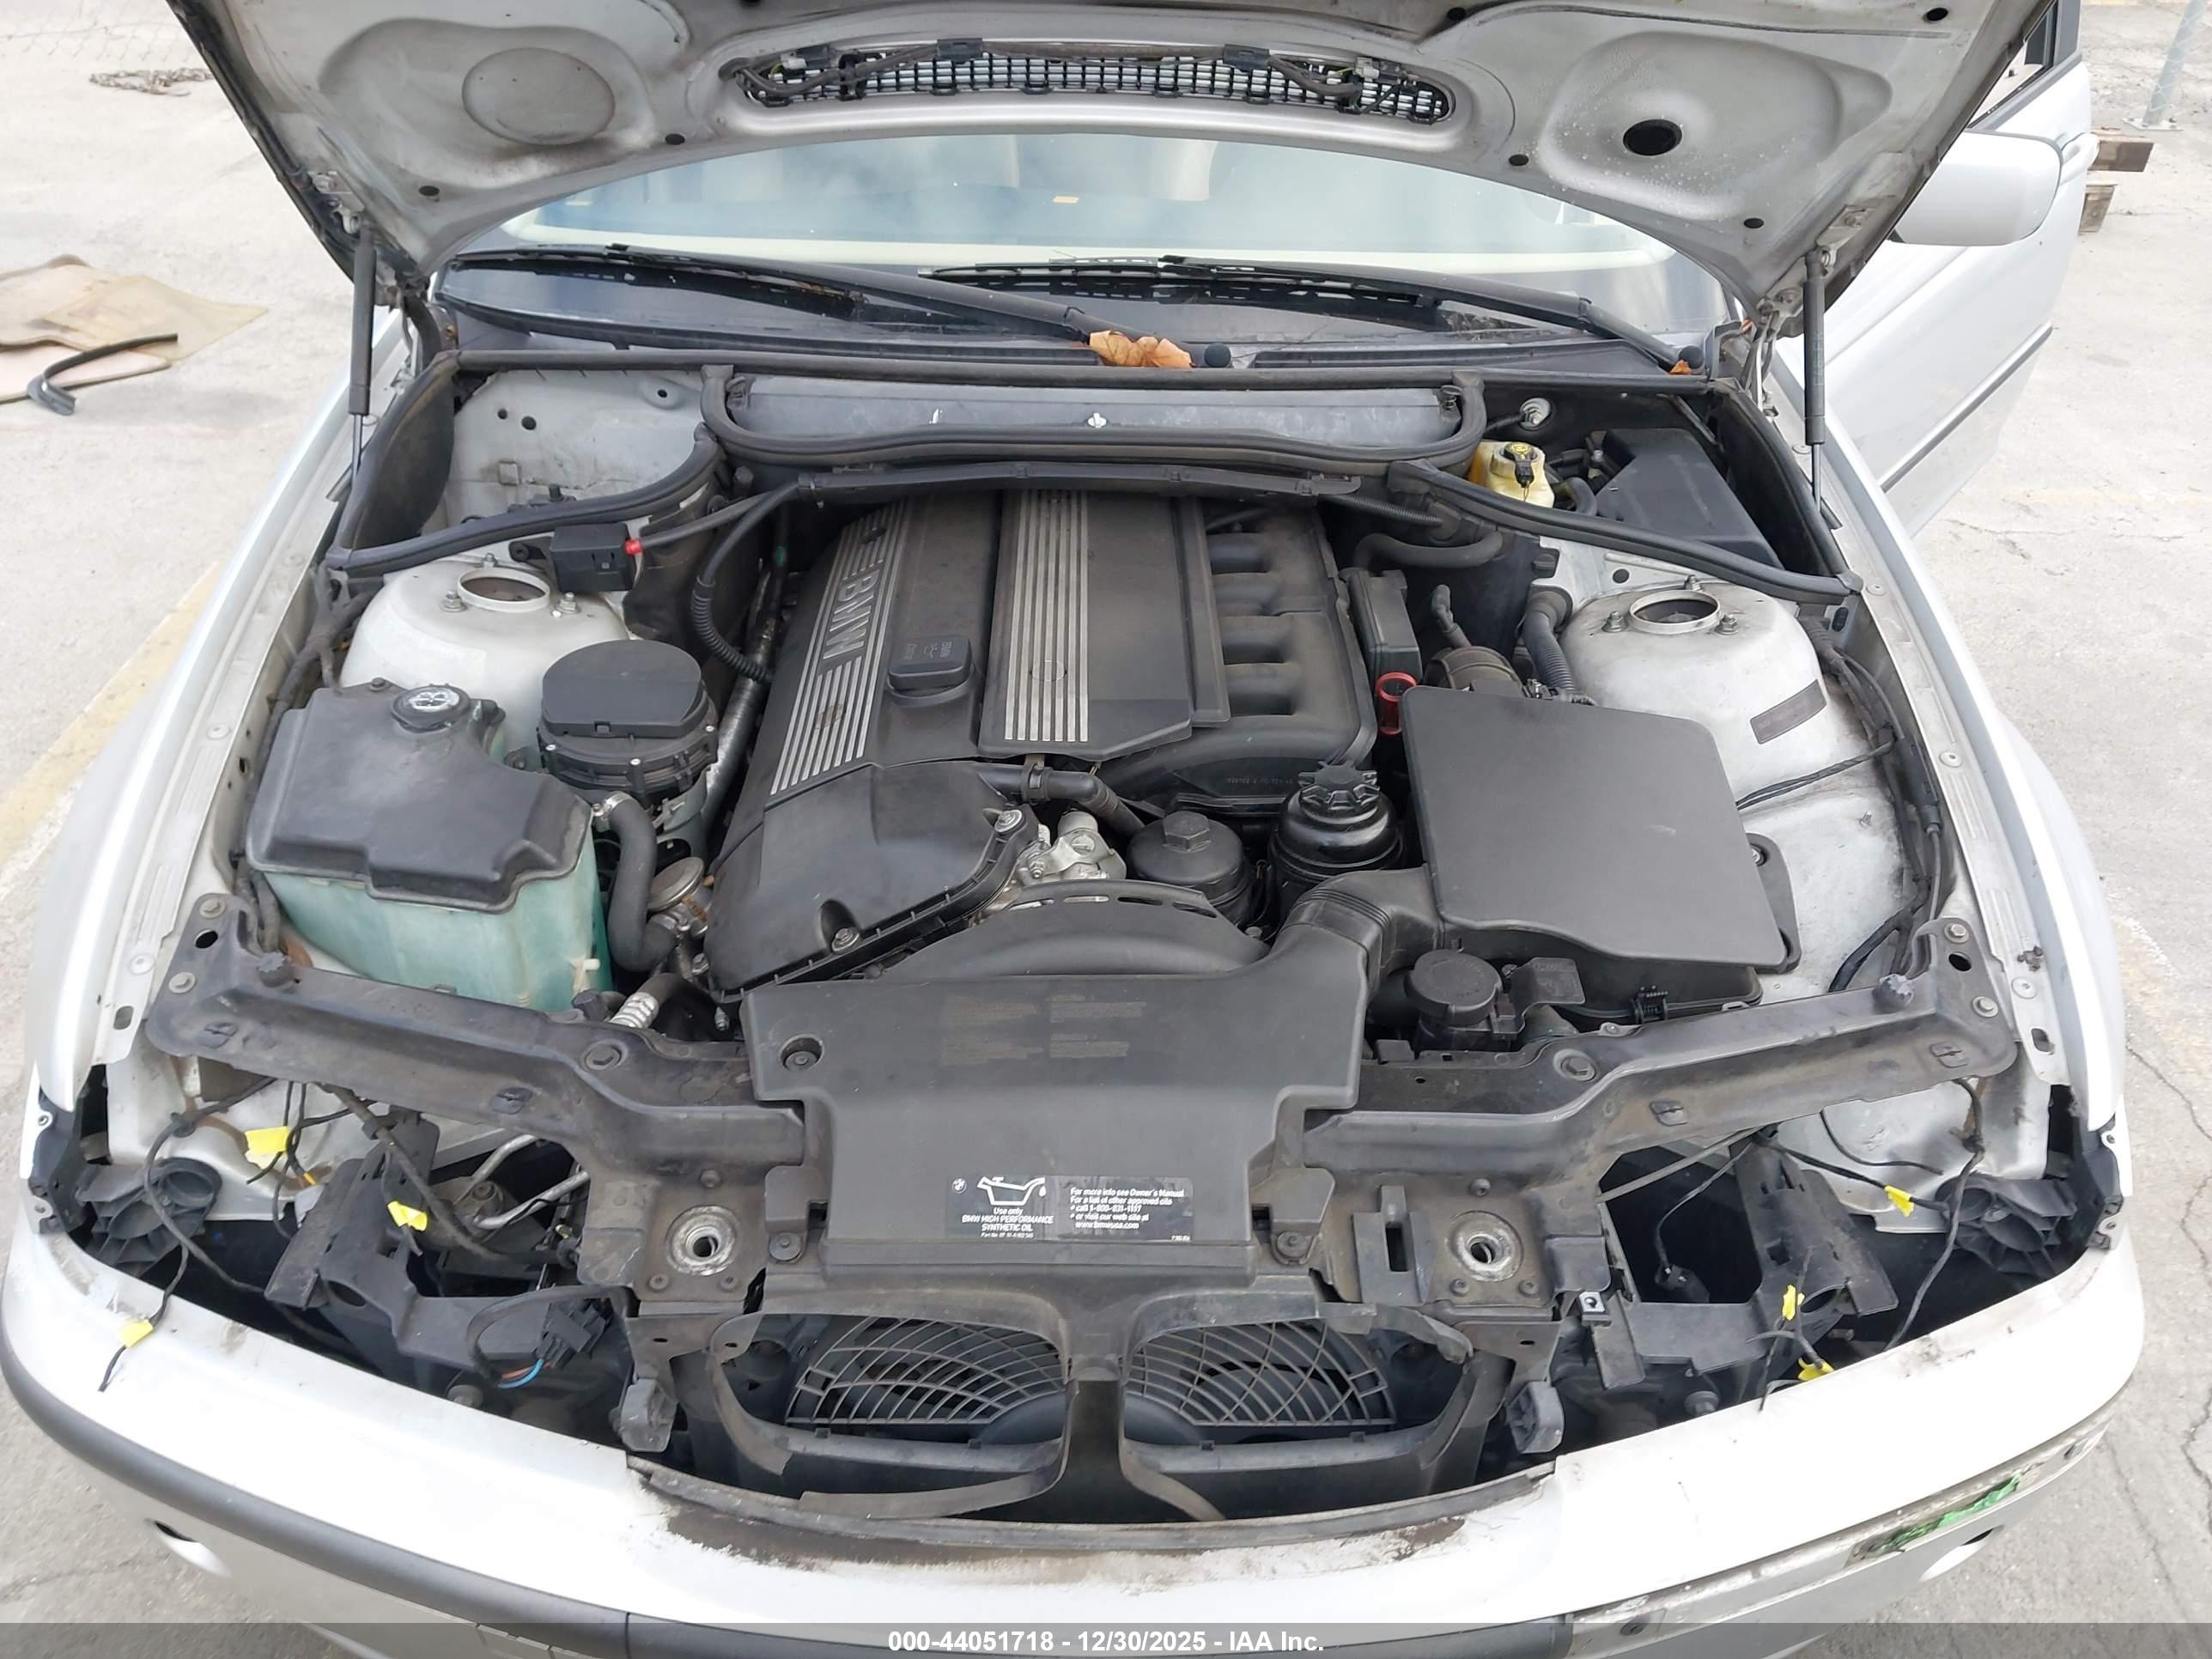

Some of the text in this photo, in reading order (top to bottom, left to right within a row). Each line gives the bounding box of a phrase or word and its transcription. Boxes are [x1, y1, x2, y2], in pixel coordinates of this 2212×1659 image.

[823, 568, 880, 660] BMW
[1007, 1207, 1024, 1217] only
[962, 1214, 981, 1223] BMW
[1000, 1215, 1054, 1224] PERFORMANCE
